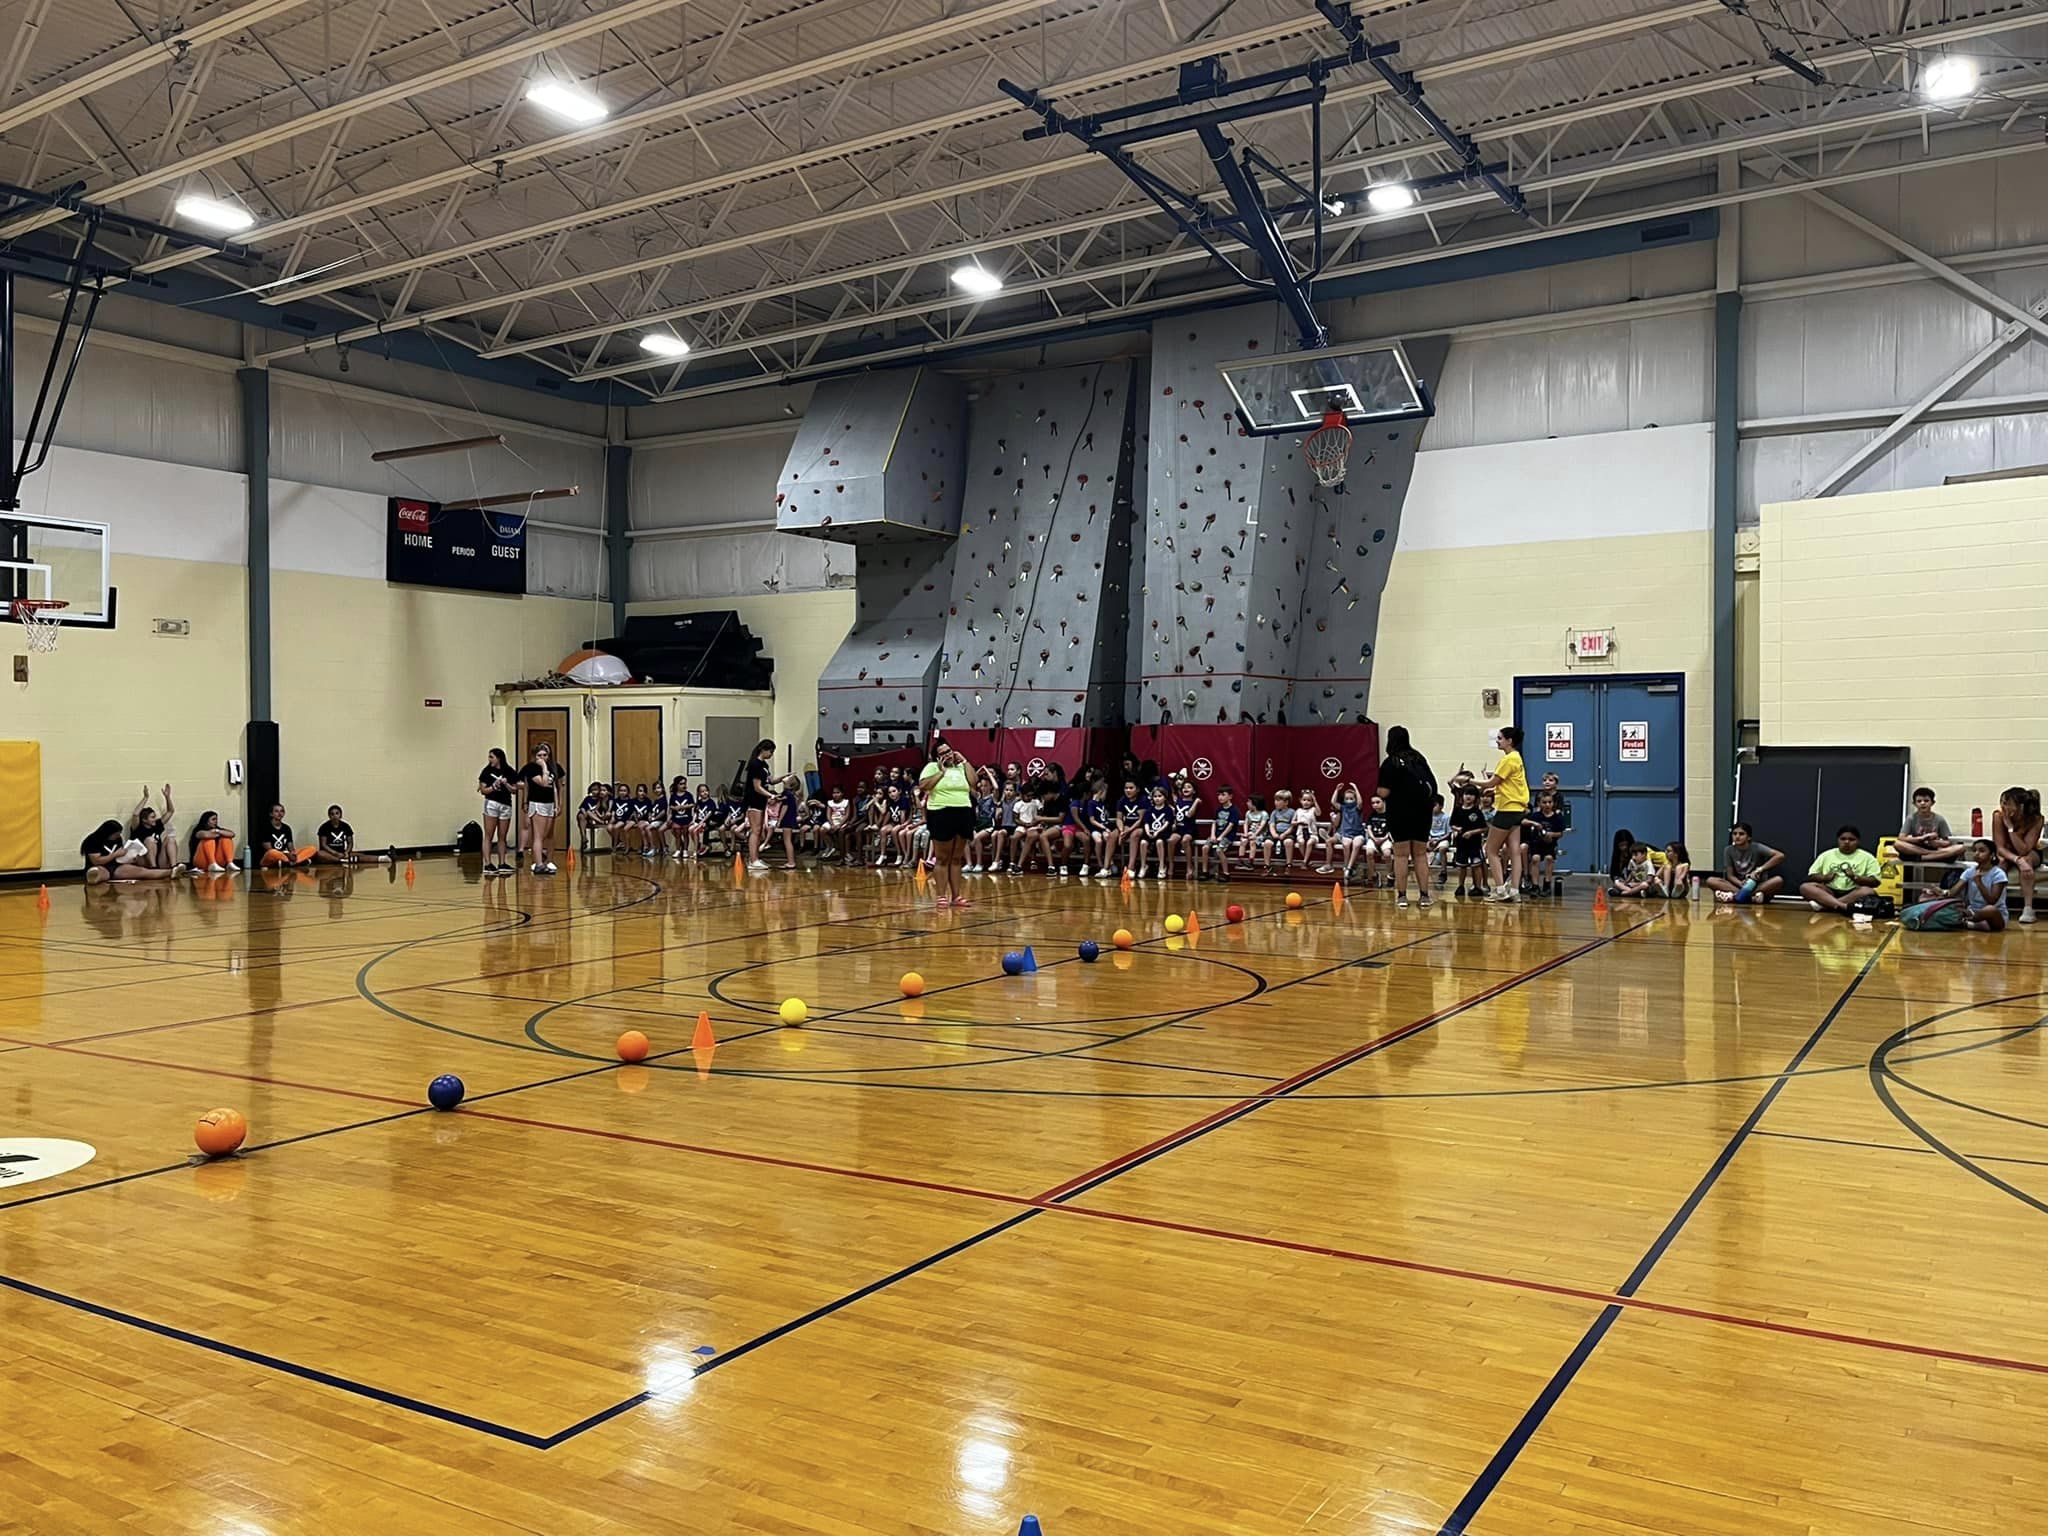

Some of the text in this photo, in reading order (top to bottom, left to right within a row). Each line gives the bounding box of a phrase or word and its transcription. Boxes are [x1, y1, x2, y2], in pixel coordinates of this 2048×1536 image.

[404, 533, 433, 548] HOME
[451, 546, 476, 557] PERIOD
[491, 545, 520, 559] GUEST
[1582, 636, 1603, 651] EXIT
